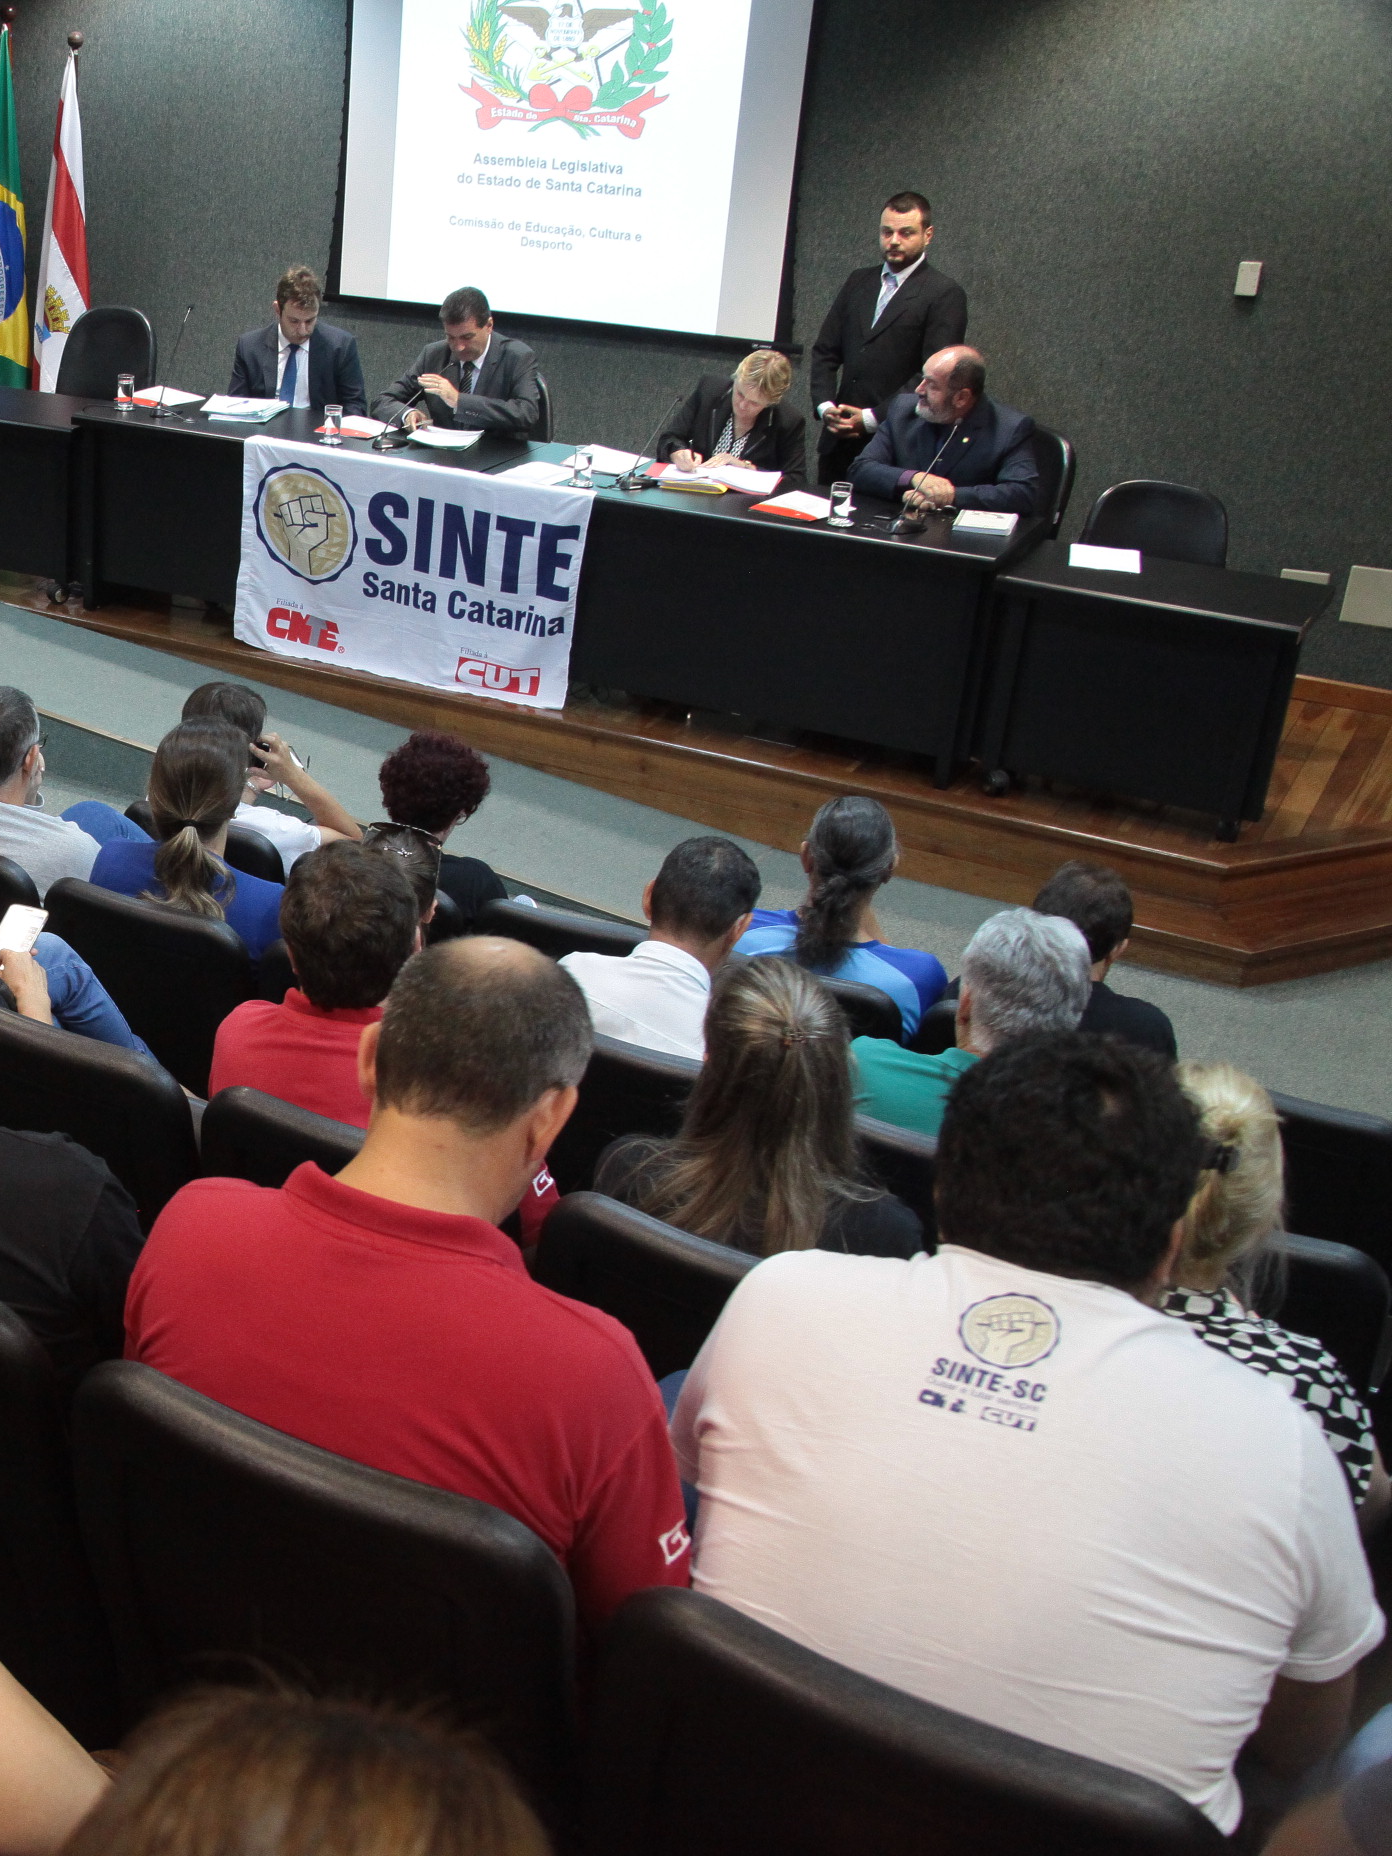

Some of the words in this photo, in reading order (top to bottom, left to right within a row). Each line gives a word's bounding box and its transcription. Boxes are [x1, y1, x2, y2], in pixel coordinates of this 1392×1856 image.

[490, 107, 524, 119] Estado
[594, 114, 638, 128] Catarina
[473, 153, 548, 169] Assembleia
[551, 158, 624, 175] Legislativa
[456, 172, 473, 184] do
[477, 173, 522, 188] Estado
[525, 177, 541, 189] de
[545, 178, 583, 193] Santa
[586, 181, 643, 198] Catarina
[448, 215, 504, 230] Comissão
[508, 220, 522, 231] de
[525, 221, 585, 238] Educação,
[589, 227, 632, 241] Cultura
[634, 233, 643, 242] e
[520, 236, 573, 251] Desporto
[364, 491, 582, 602] SINTE
[276, 597, 298, 608] Filiada
[362, 571, 436, 614] Santa
[447, 590, 565, 638] Catarina
[266, 607, 340, 652] CNTE
[460, 647, 482, 658] Filiada
[457, 660, 539, 694] CUT
[931, 1357, 1048, 1402] SINTE-SC
